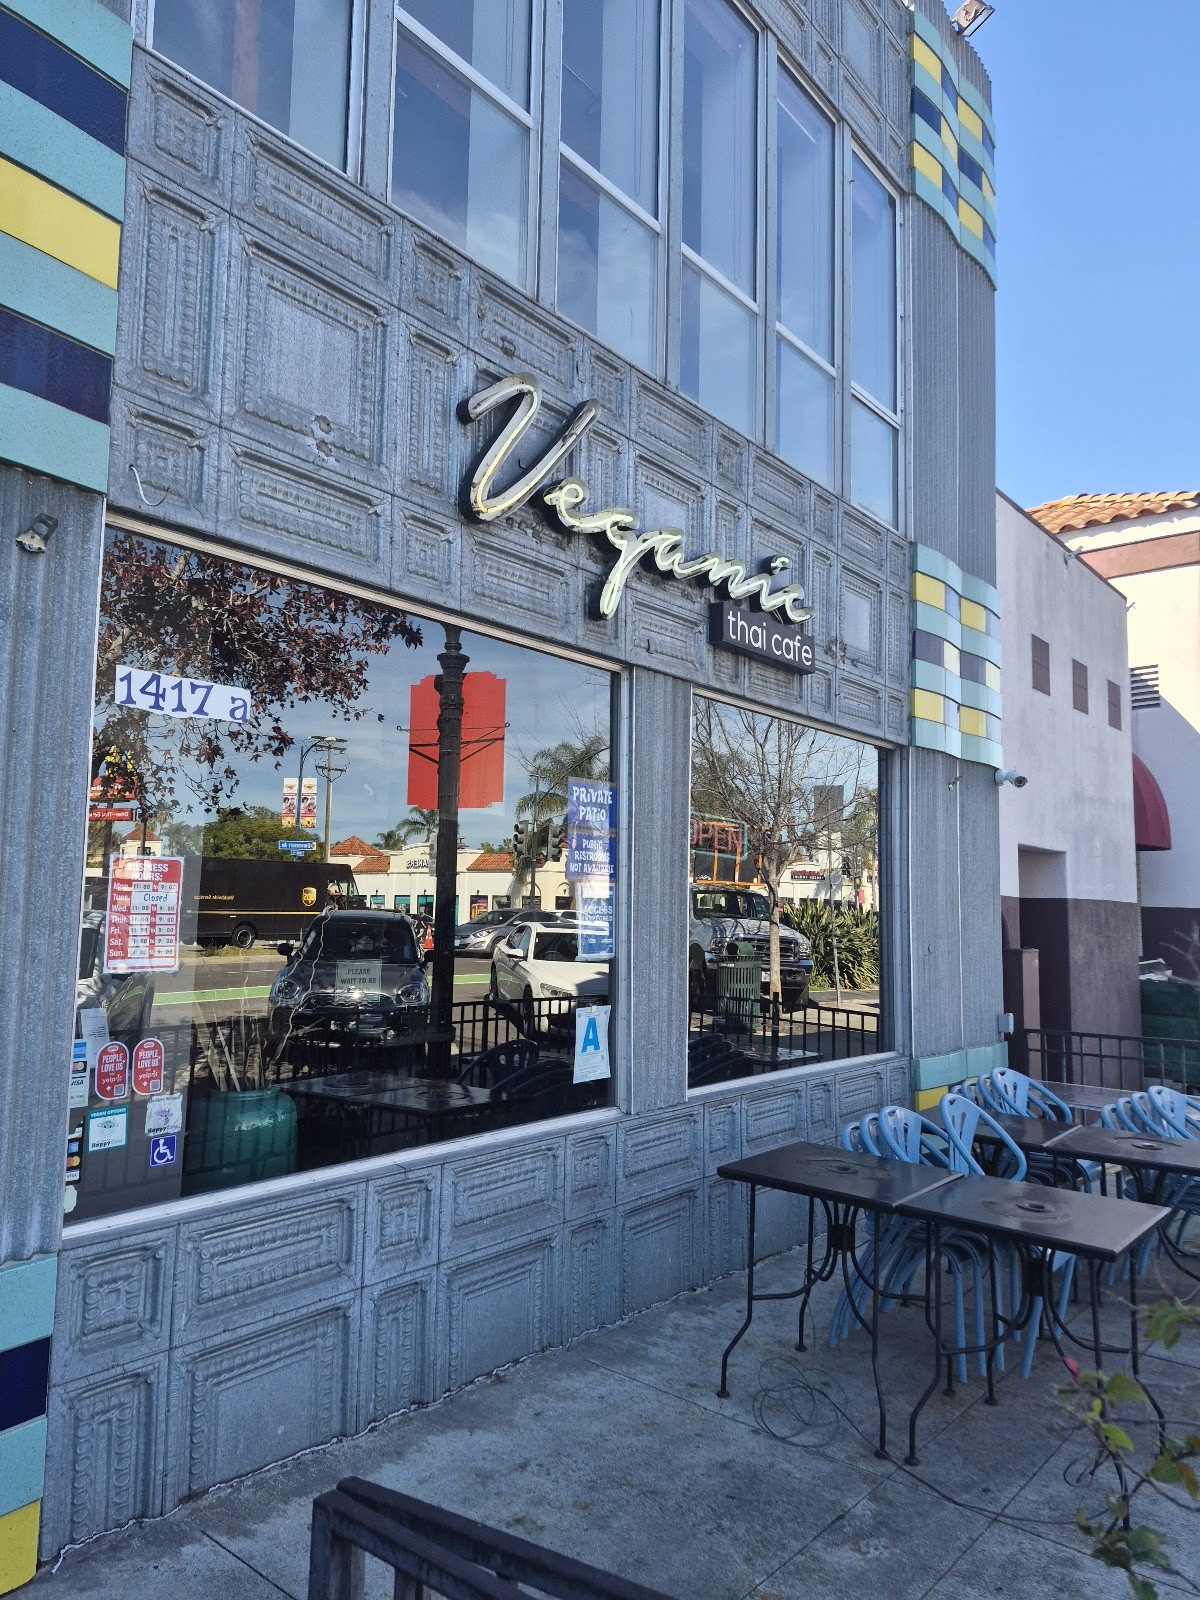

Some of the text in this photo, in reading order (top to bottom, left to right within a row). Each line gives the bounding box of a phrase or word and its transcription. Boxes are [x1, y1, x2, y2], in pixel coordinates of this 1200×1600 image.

[460, 372, 815, 624] Veganic
[726, 609, 813, 666] thai cafe
[118, 670, 249, 723] 1417 a
[126, 863, 169, 873] BUSINESS
[569, 862, 582, 872] NOT
[143, 893, 168, 902] Closed
[584, 905, 613, 915] ACCESS
[581, 1017, 601, 1053] A
[102, 1053, 124, 1063] PEOPLE
[139, 1050, 159, 1060] PEOPLE
[101, 1062, 124, 1073] LOVE US
[138, 1058, 159, 1069] LOVE US
[101, 1076, 116, 1084] yelp
[138, 1072, 152, 1080] yelp
[106, 1107, 127, 1115] OPTIONS
